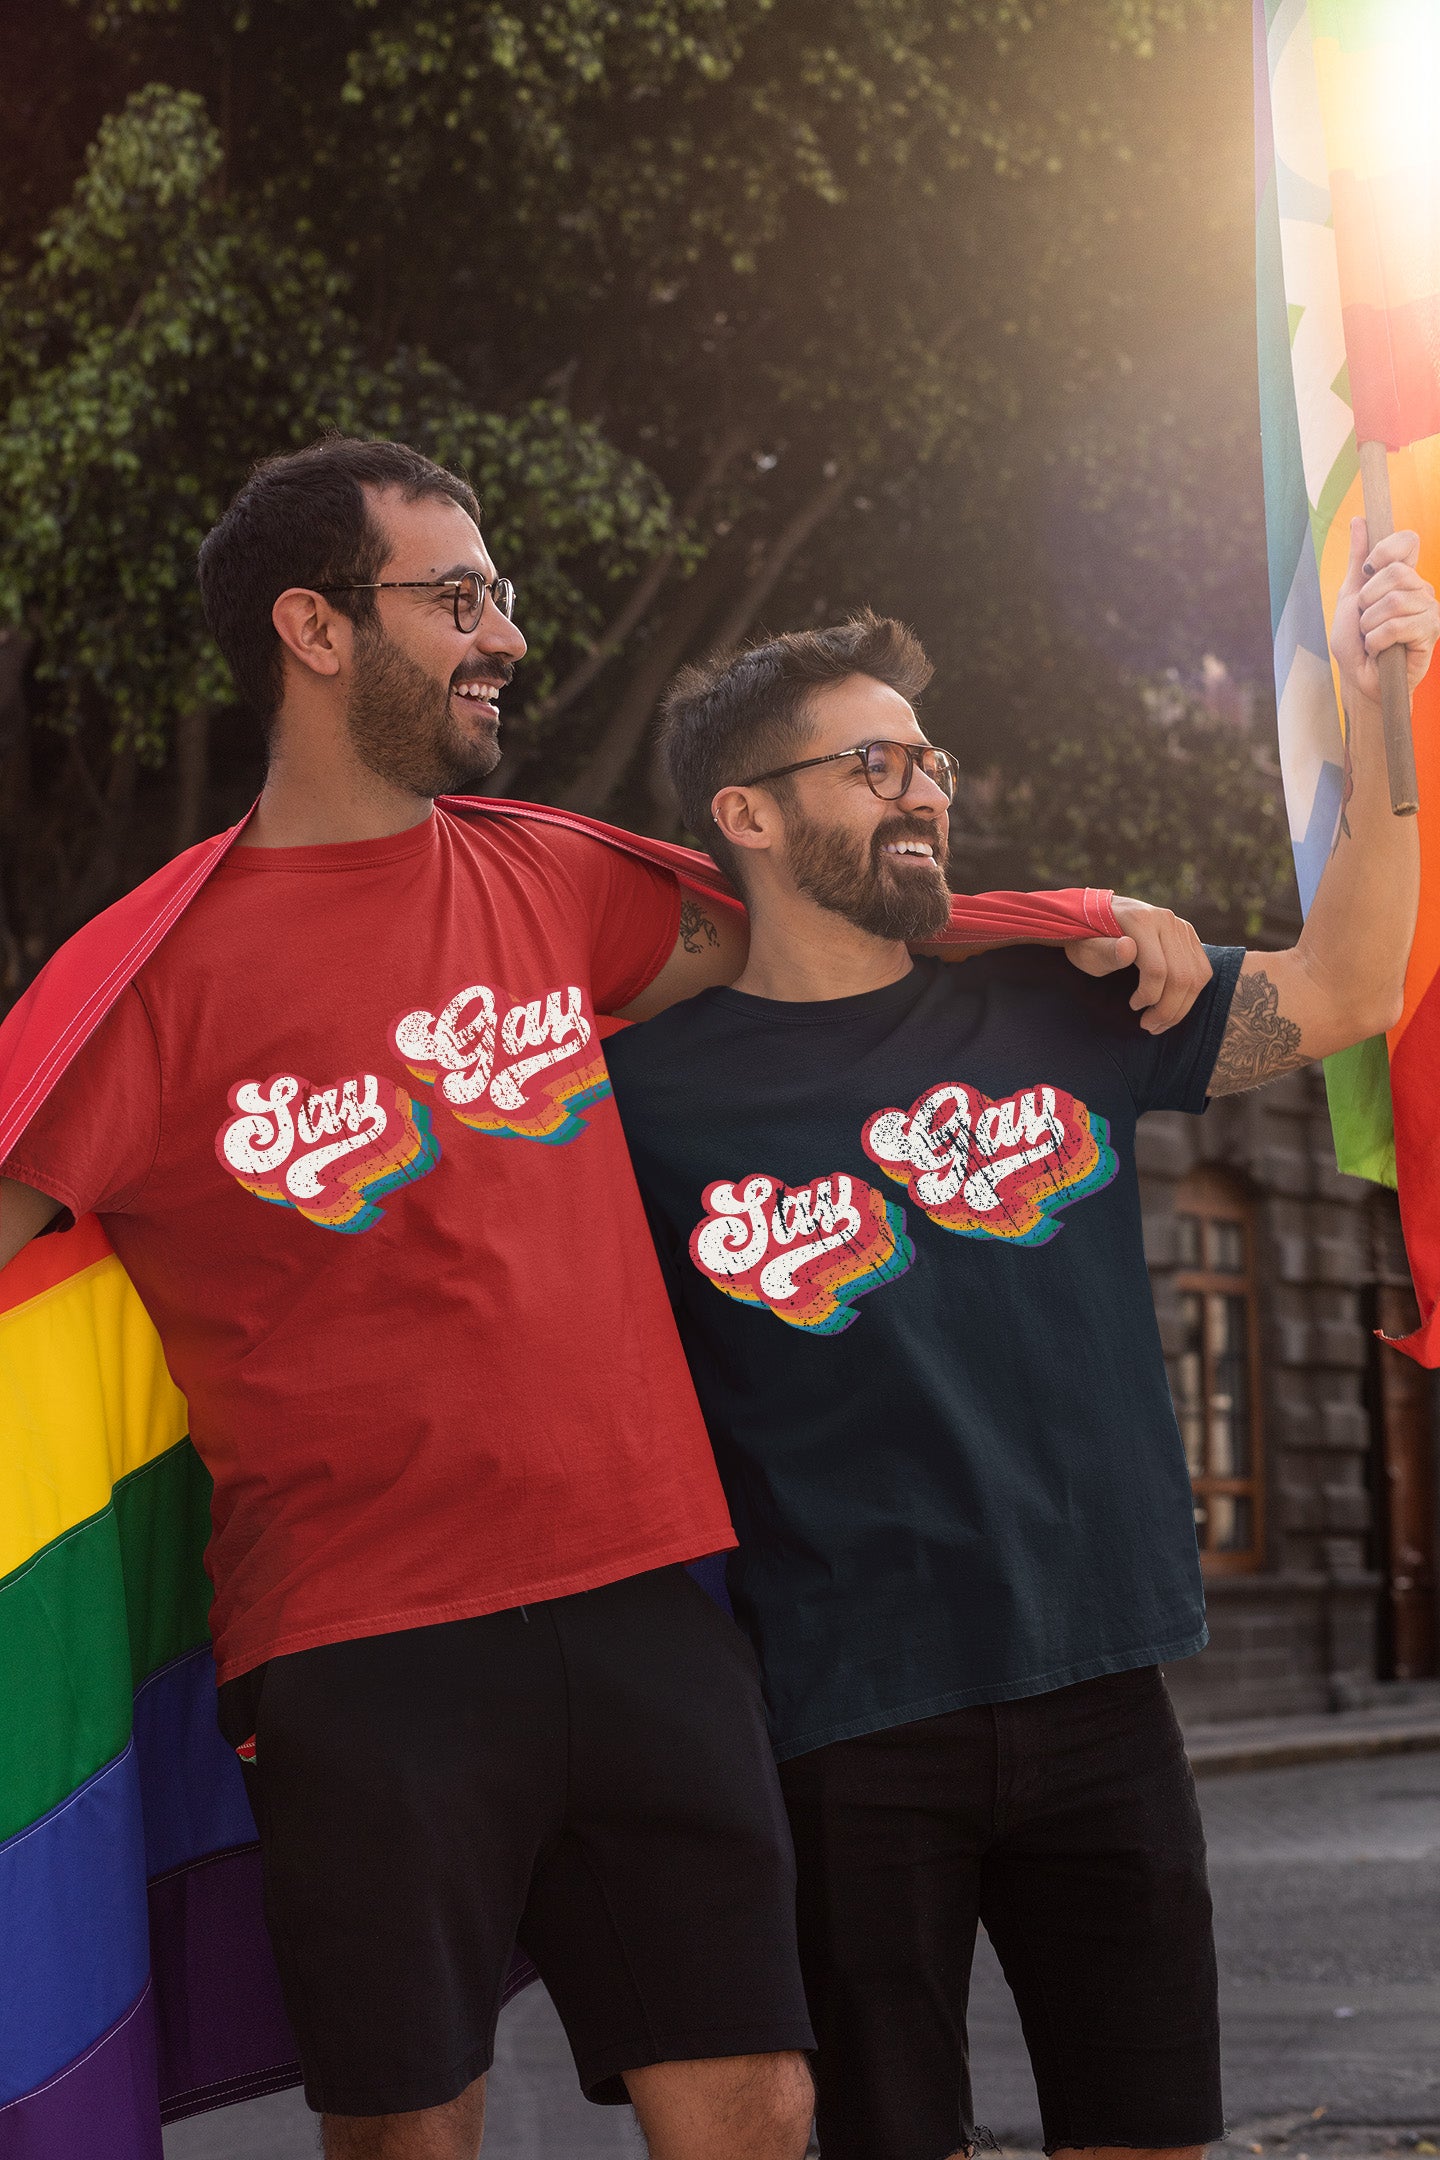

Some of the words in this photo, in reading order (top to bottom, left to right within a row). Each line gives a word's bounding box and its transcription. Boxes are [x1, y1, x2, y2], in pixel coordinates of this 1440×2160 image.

[223, 1074, 388, 1199] Say
[395, 985, 592, 1111] Gay
[697, 1175, 861, 1300] Say
[869, 1086, 1065, 1211] Gay
